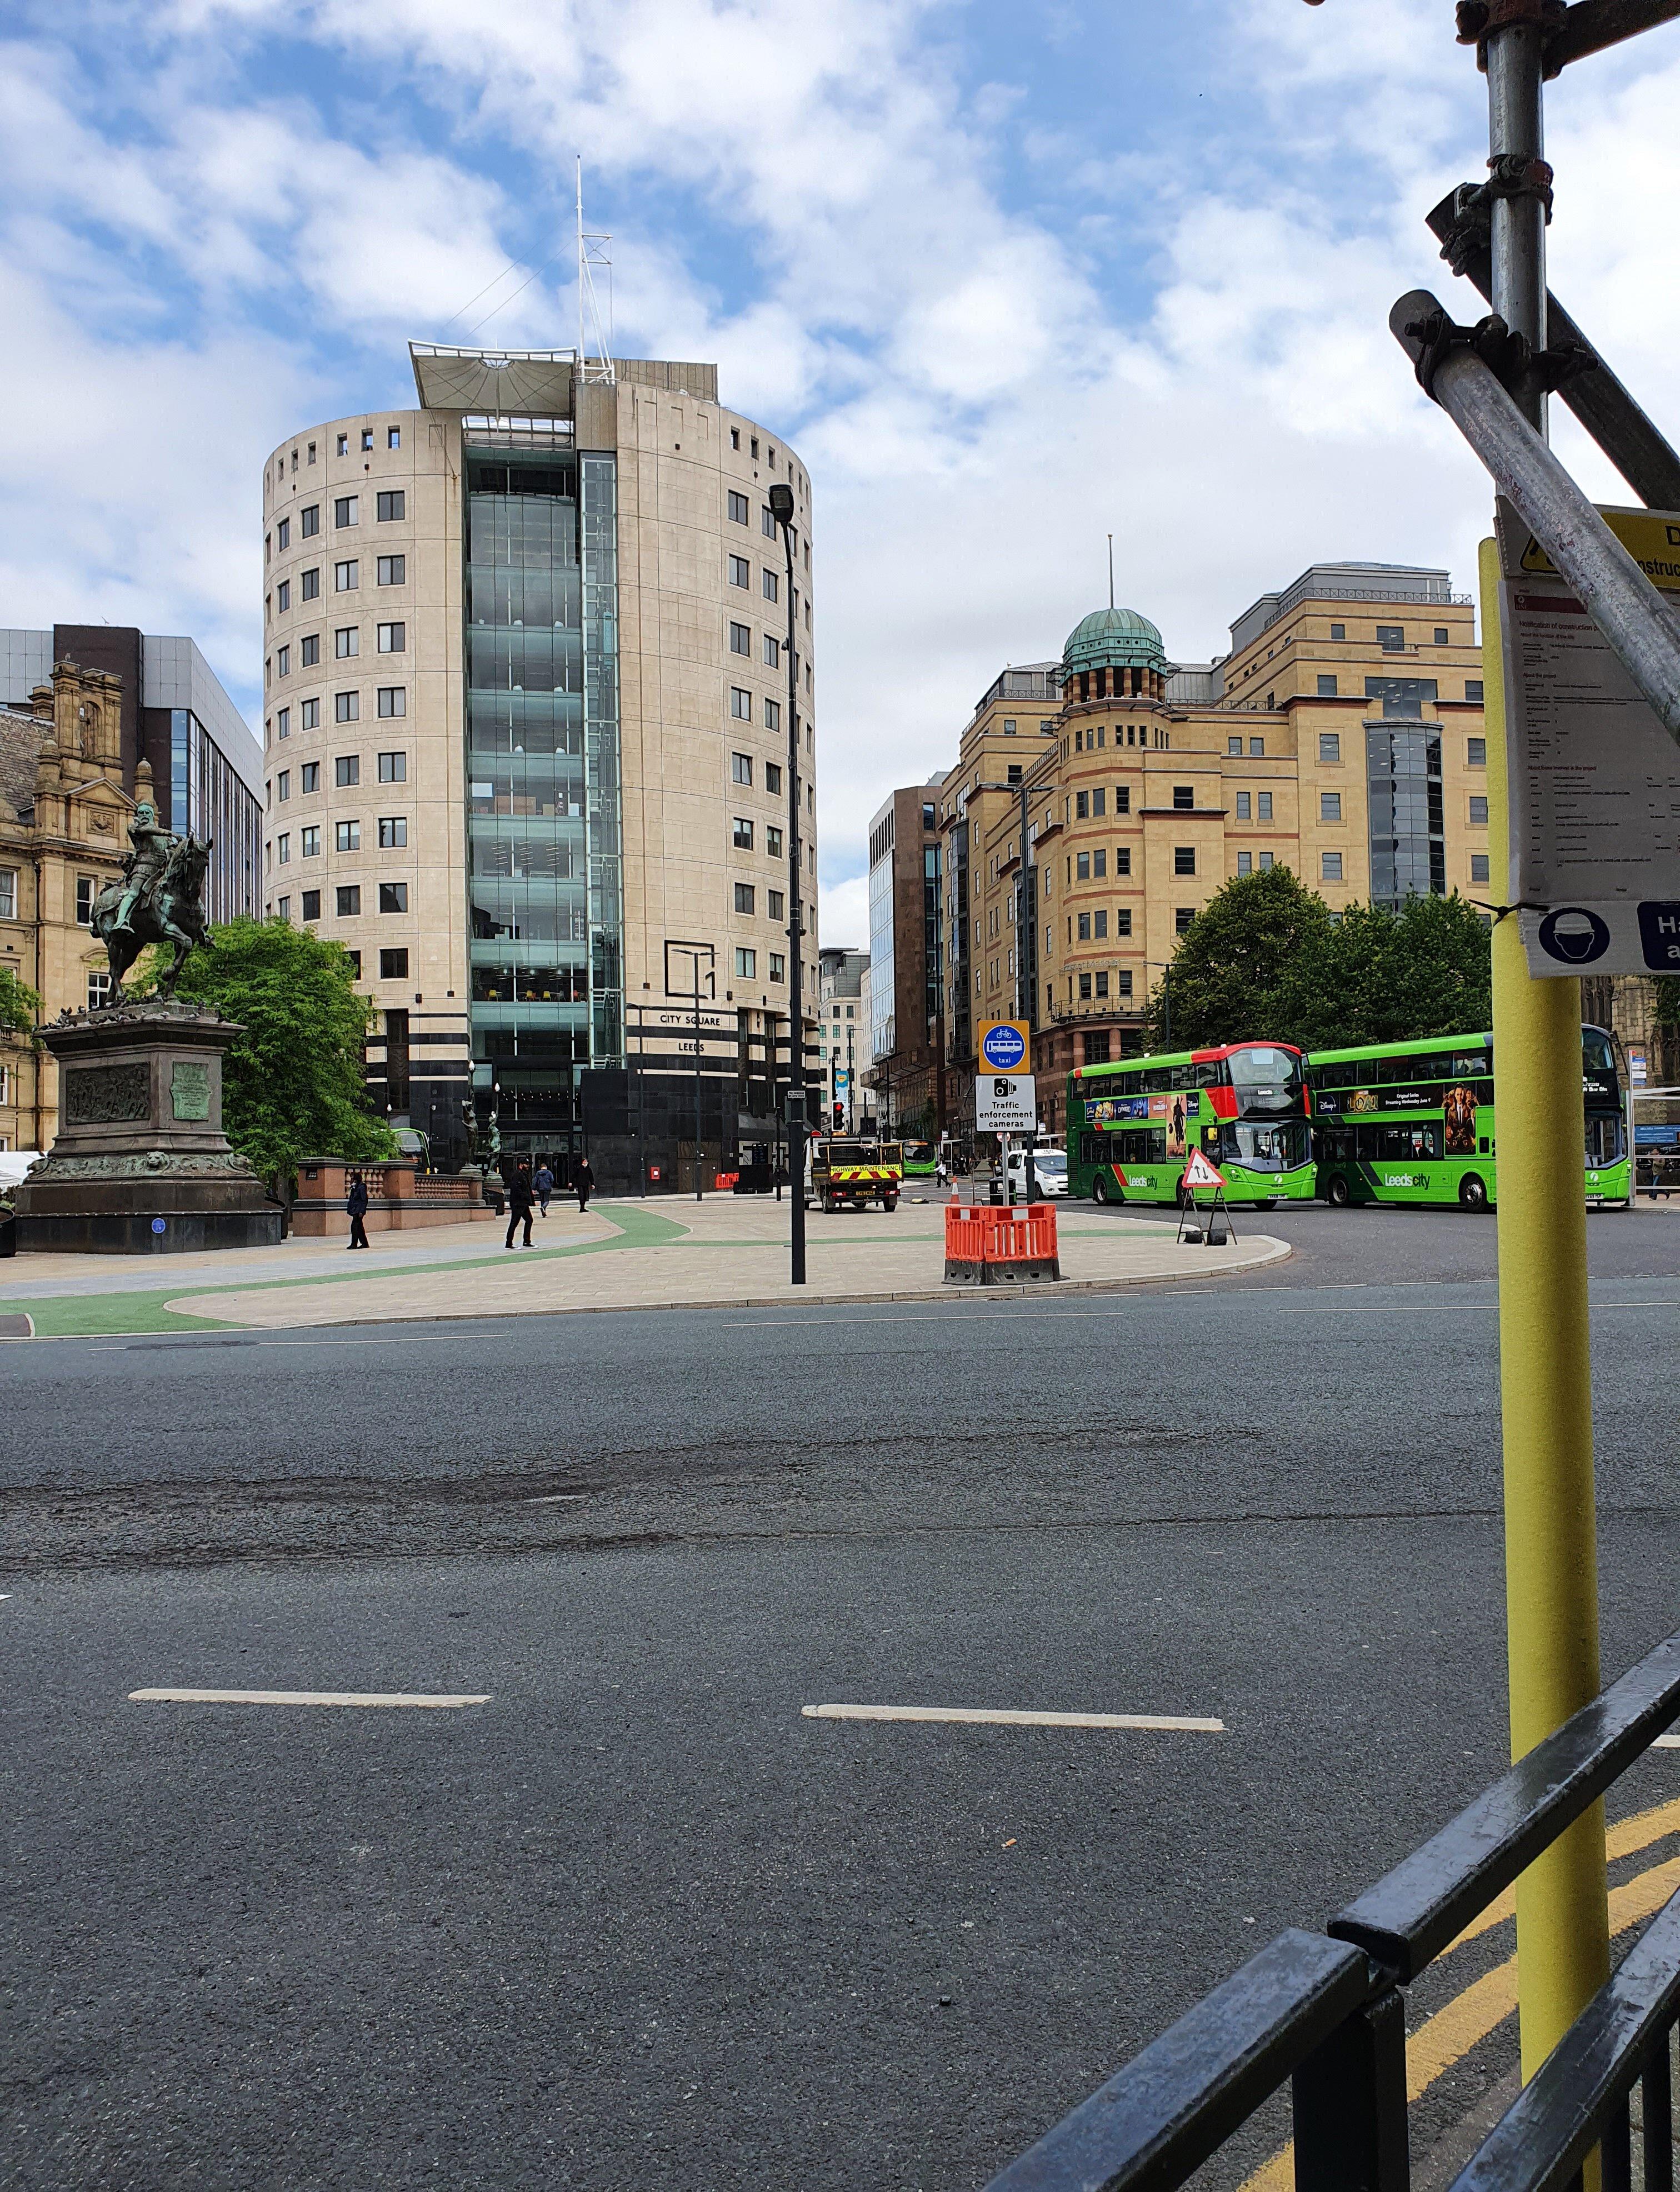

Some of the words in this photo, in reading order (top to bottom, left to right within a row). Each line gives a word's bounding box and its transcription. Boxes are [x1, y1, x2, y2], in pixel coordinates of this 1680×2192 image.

[1519, 620, 1550, 629] Notification
[660, 1014, 681, 1024] CITY
[686, 1015, 721, 1026] SQUARE
